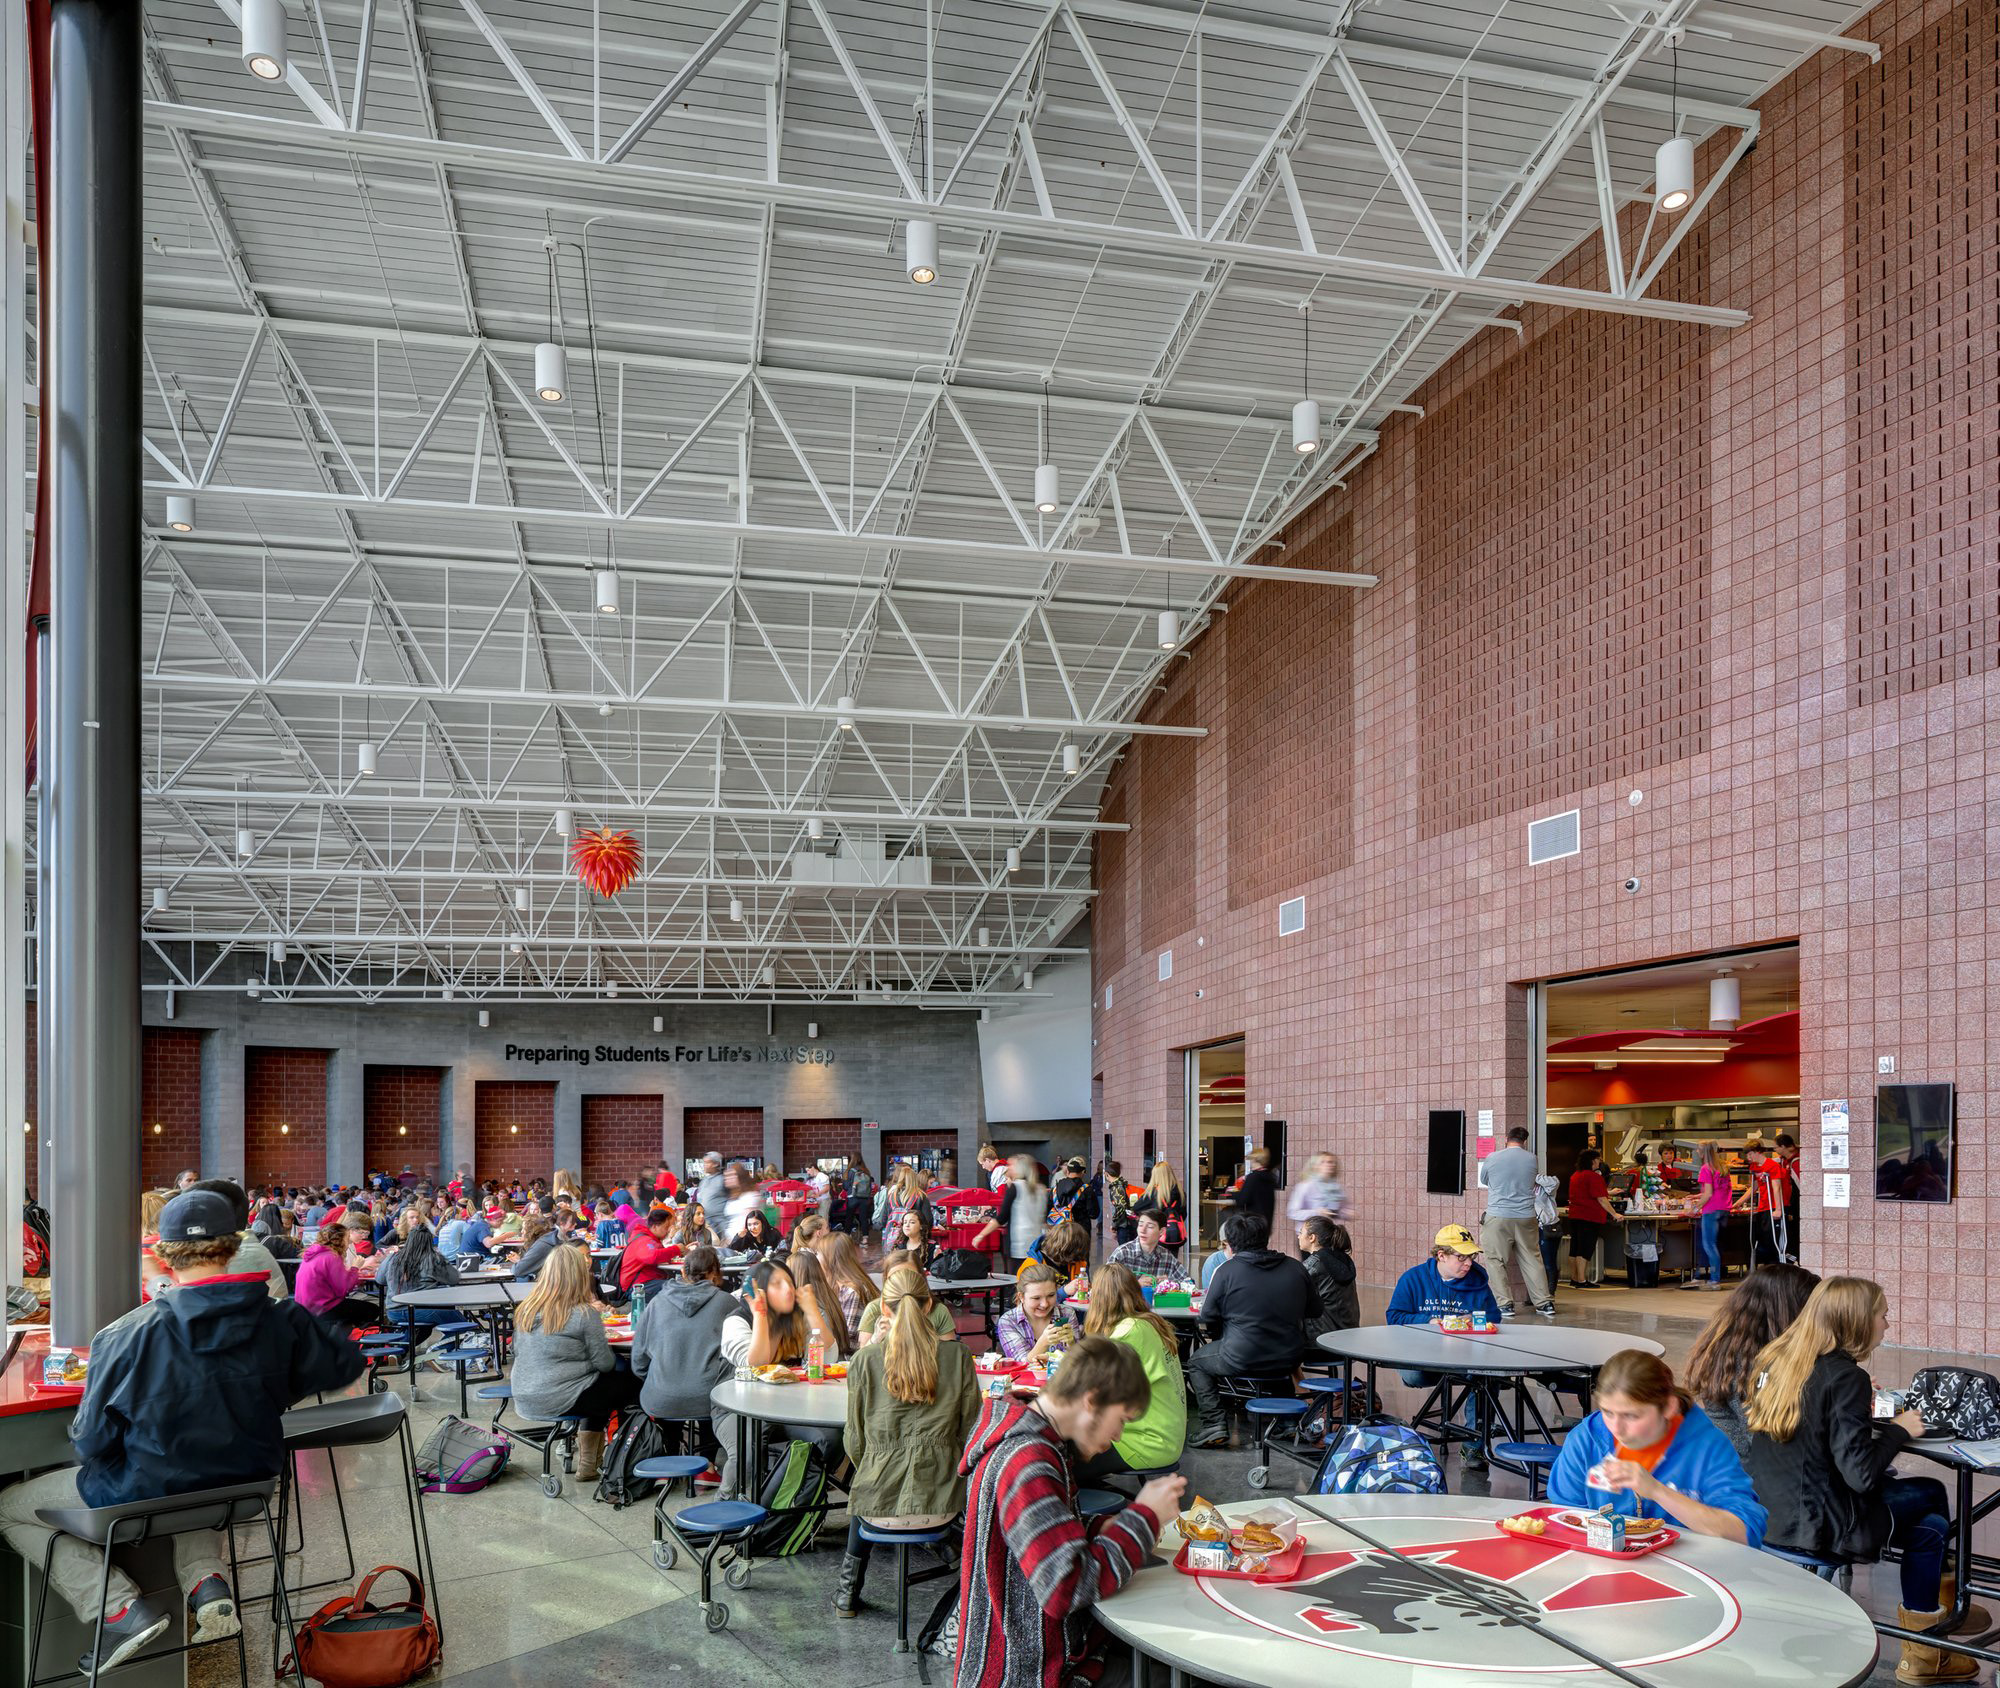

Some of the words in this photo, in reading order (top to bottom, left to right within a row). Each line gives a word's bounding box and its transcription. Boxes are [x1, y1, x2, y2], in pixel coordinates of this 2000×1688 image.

[505, 1044, 590, 1066] Preparing
[594, 1045, 670, 1062] Students
[675, 1046, 704, 1062] For
[707, 1046, 752, 1063] Life's
[757, 1047, 794, 1063] Next
[796, 1045, 835, 1068] Step
[1460, 1231, 1475, 1242] M
